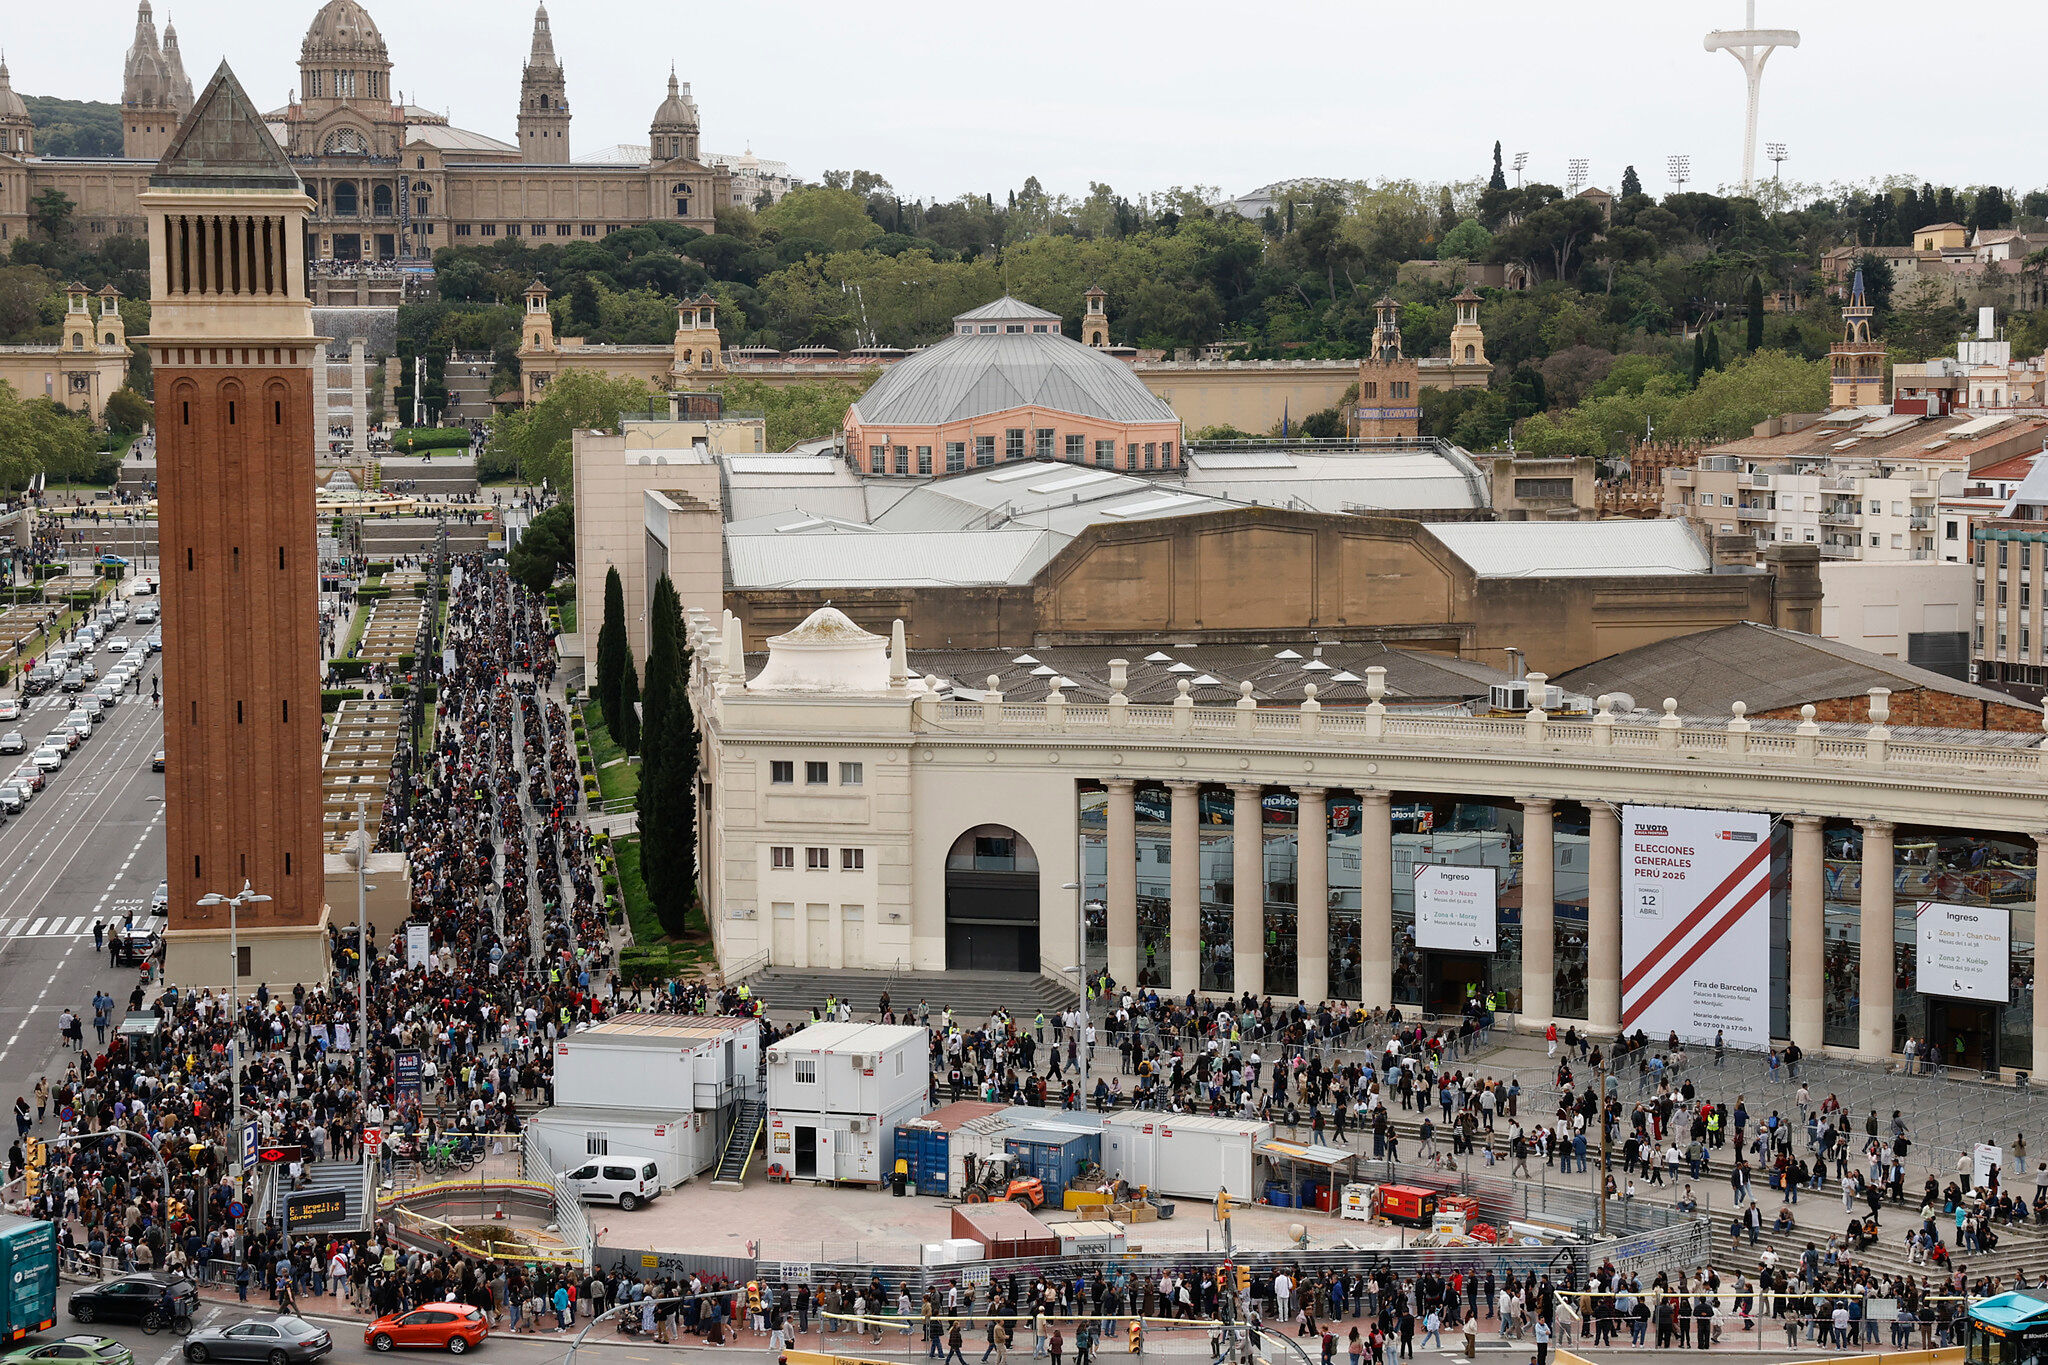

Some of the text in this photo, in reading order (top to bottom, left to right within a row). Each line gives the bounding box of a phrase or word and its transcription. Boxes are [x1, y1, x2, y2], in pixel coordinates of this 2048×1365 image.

[1635, 844, 1695, 855] ELECCIONES
[1635, 856, 1691, 867] GENERALES
[1441, 872, 1469, 881] Ingreso
[1635, 868, 1685, 880] PERÚ 2026
[1642, 896, 1656, 905] 12
[1947, 912, 1978, 922] Ingreso
[1720, 983, 1757, 993] Barcelona
[244, 1127, 254, 1157] P
